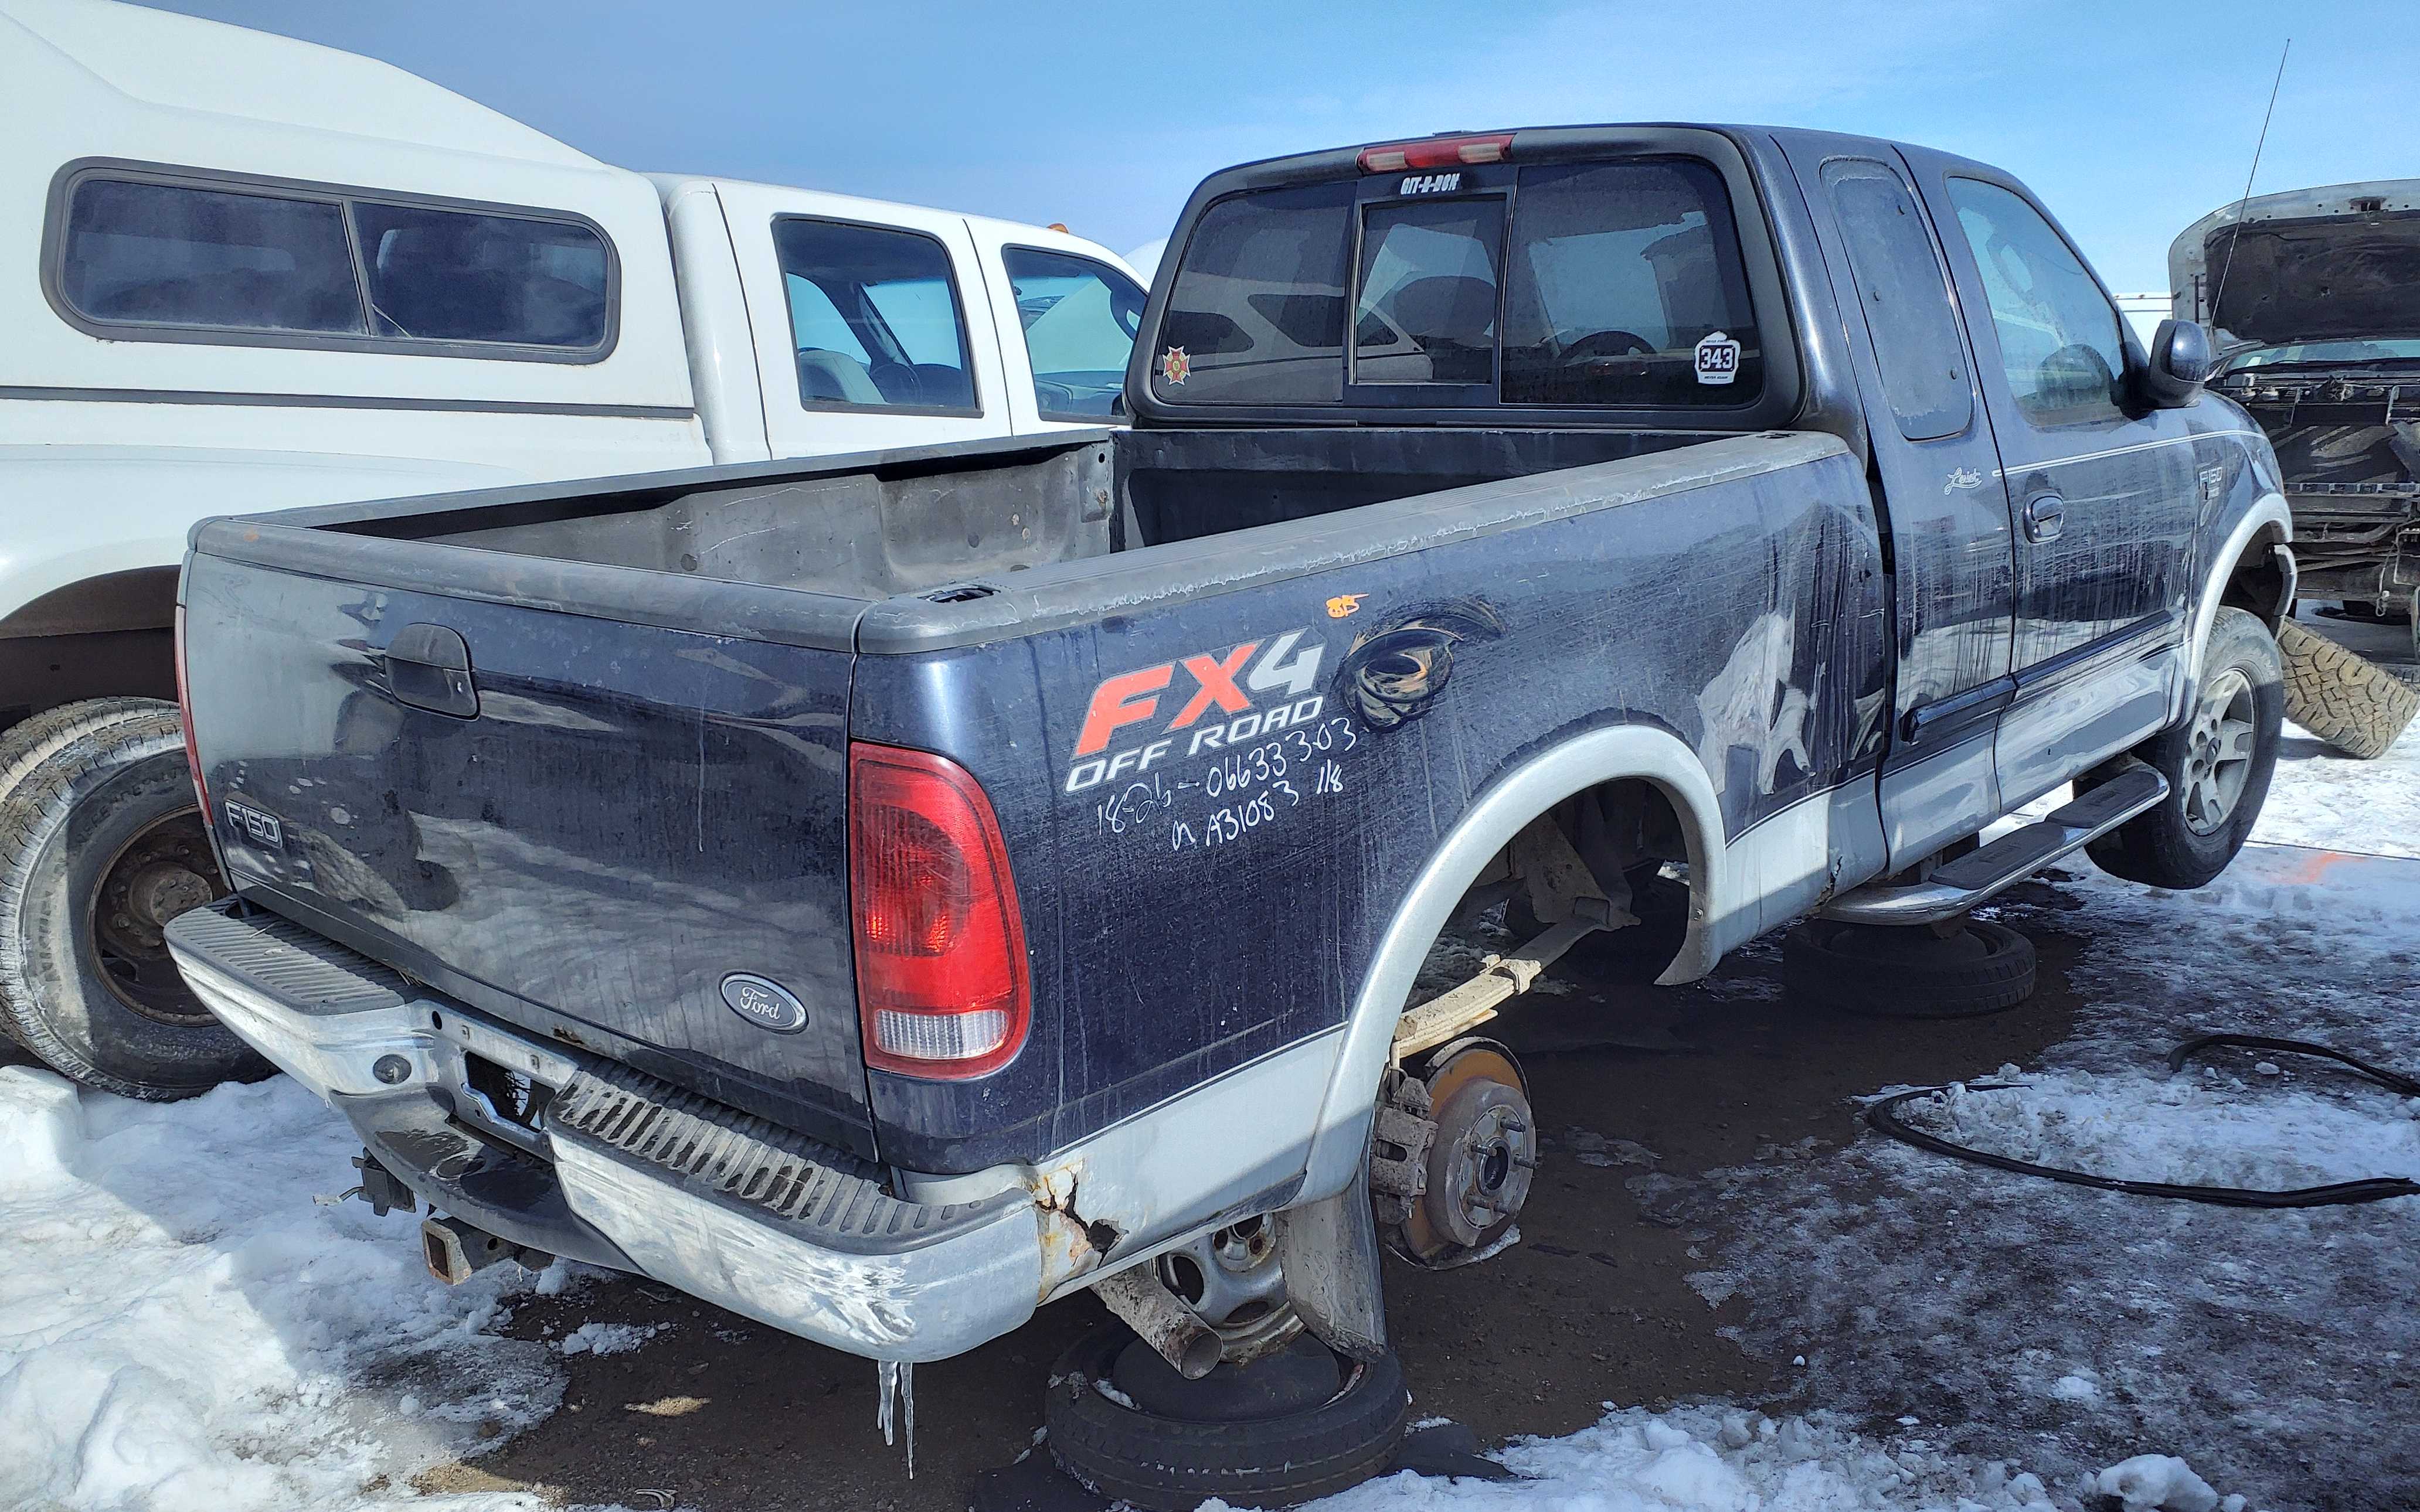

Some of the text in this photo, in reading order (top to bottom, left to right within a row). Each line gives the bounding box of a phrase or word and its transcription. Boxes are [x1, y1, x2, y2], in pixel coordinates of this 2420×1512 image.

[1701, 348, 1734, 369] 343
[1075, 627, 1324, 757] FX4
[1065, 696, 1324, 792] OFF ROAD
[740, 986, 780, 1020] Ford
